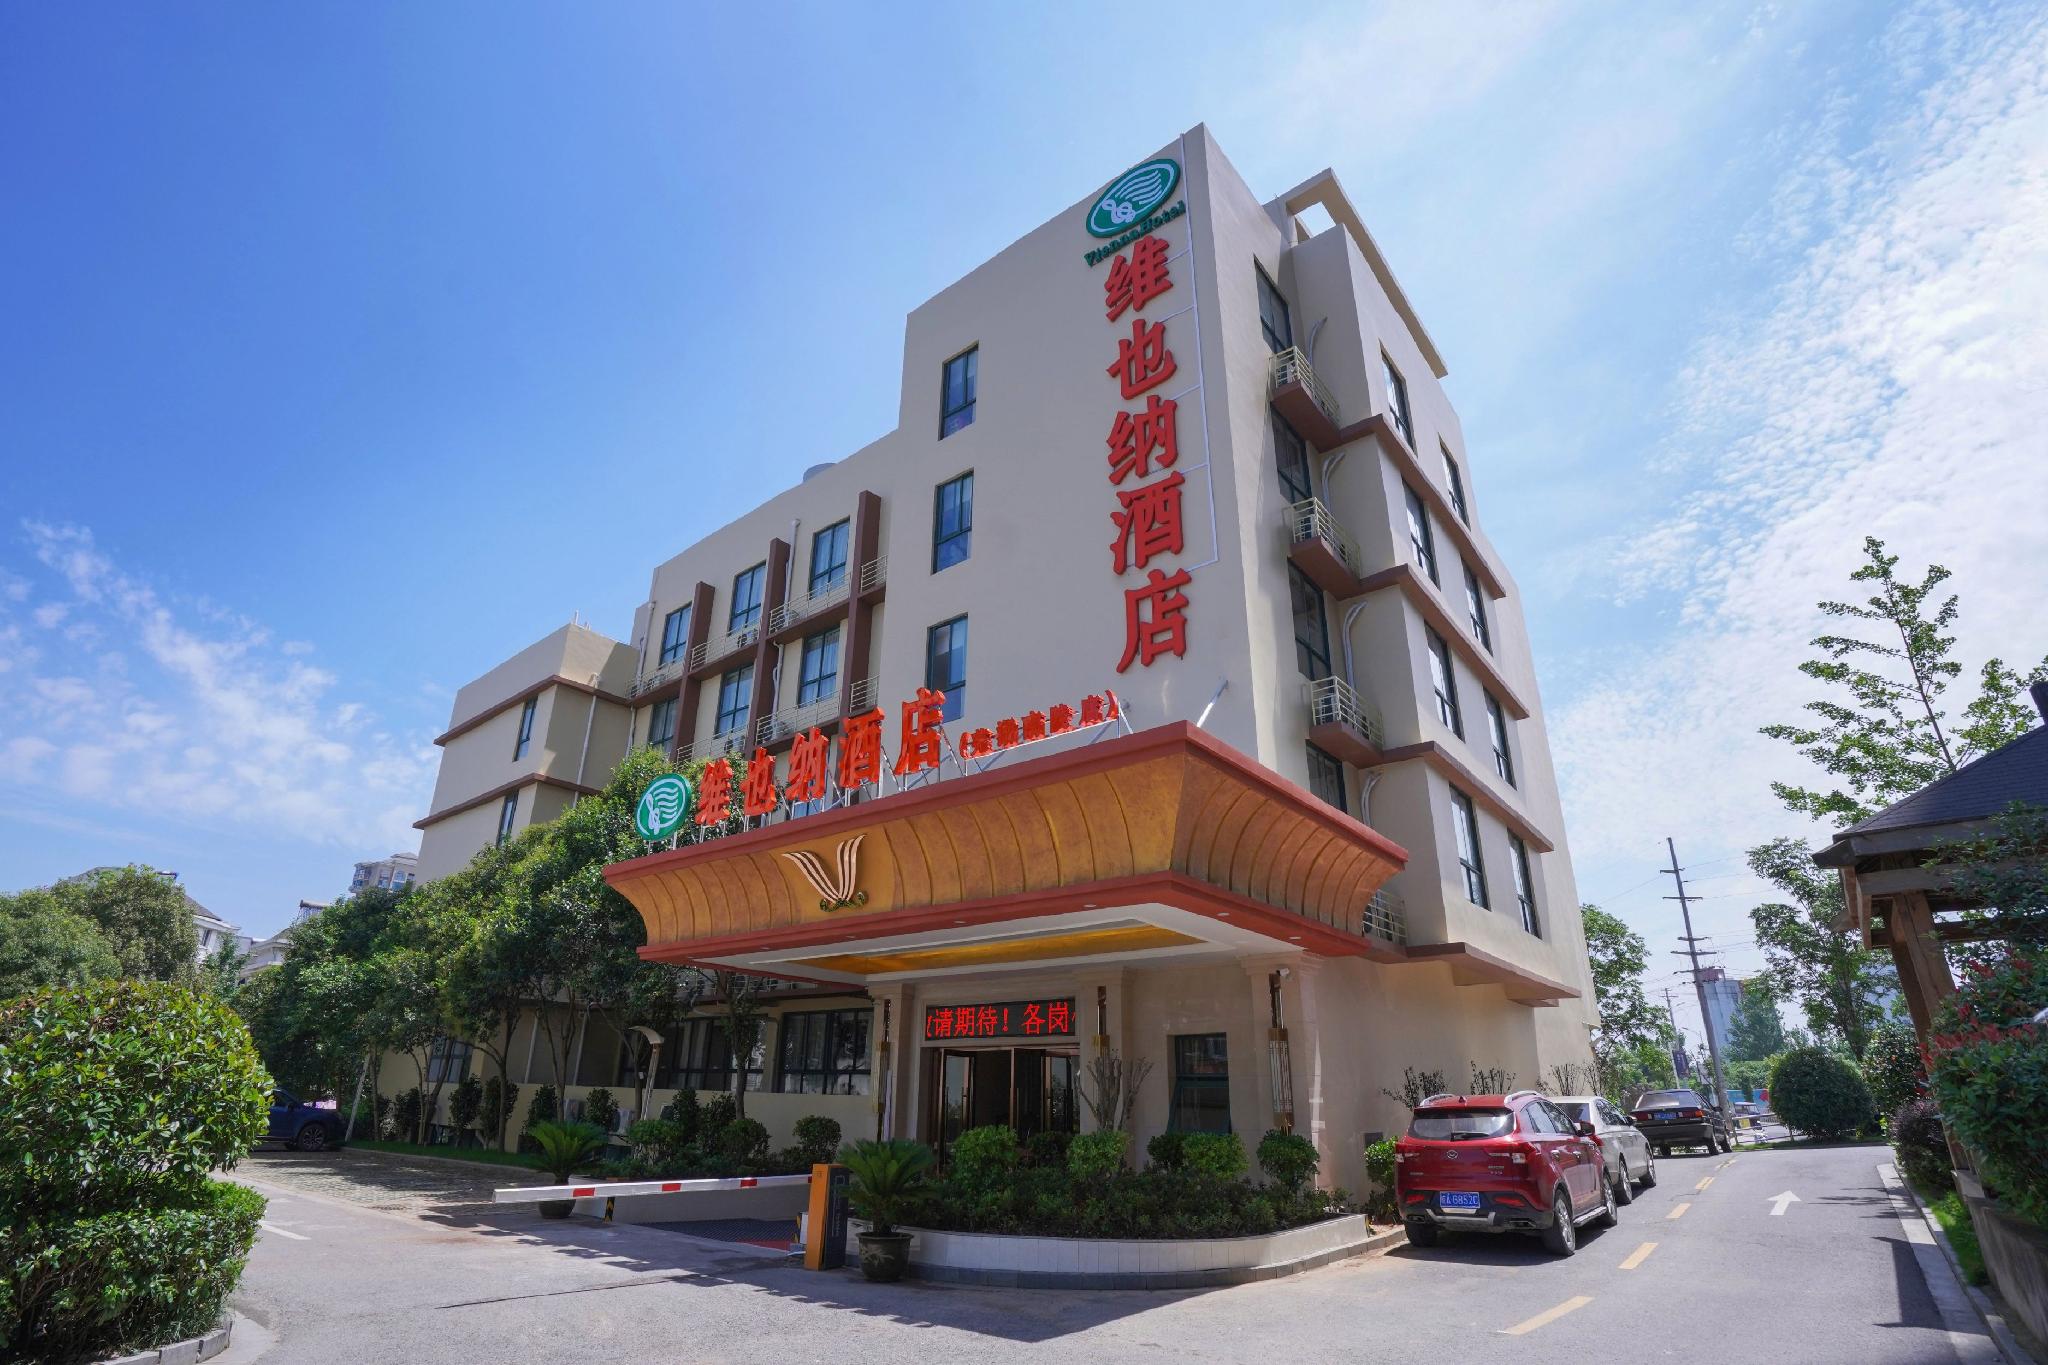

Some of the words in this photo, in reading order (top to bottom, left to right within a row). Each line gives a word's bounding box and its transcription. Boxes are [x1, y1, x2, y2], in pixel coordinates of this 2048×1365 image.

[1084, 229, 1140, 267] Vienna
[1140, 200, 1186, 237] Hotel
[1105, 235, 1192, 674] 维也纳酒店
[695, 687, 946, 826] 维也纳酒店
